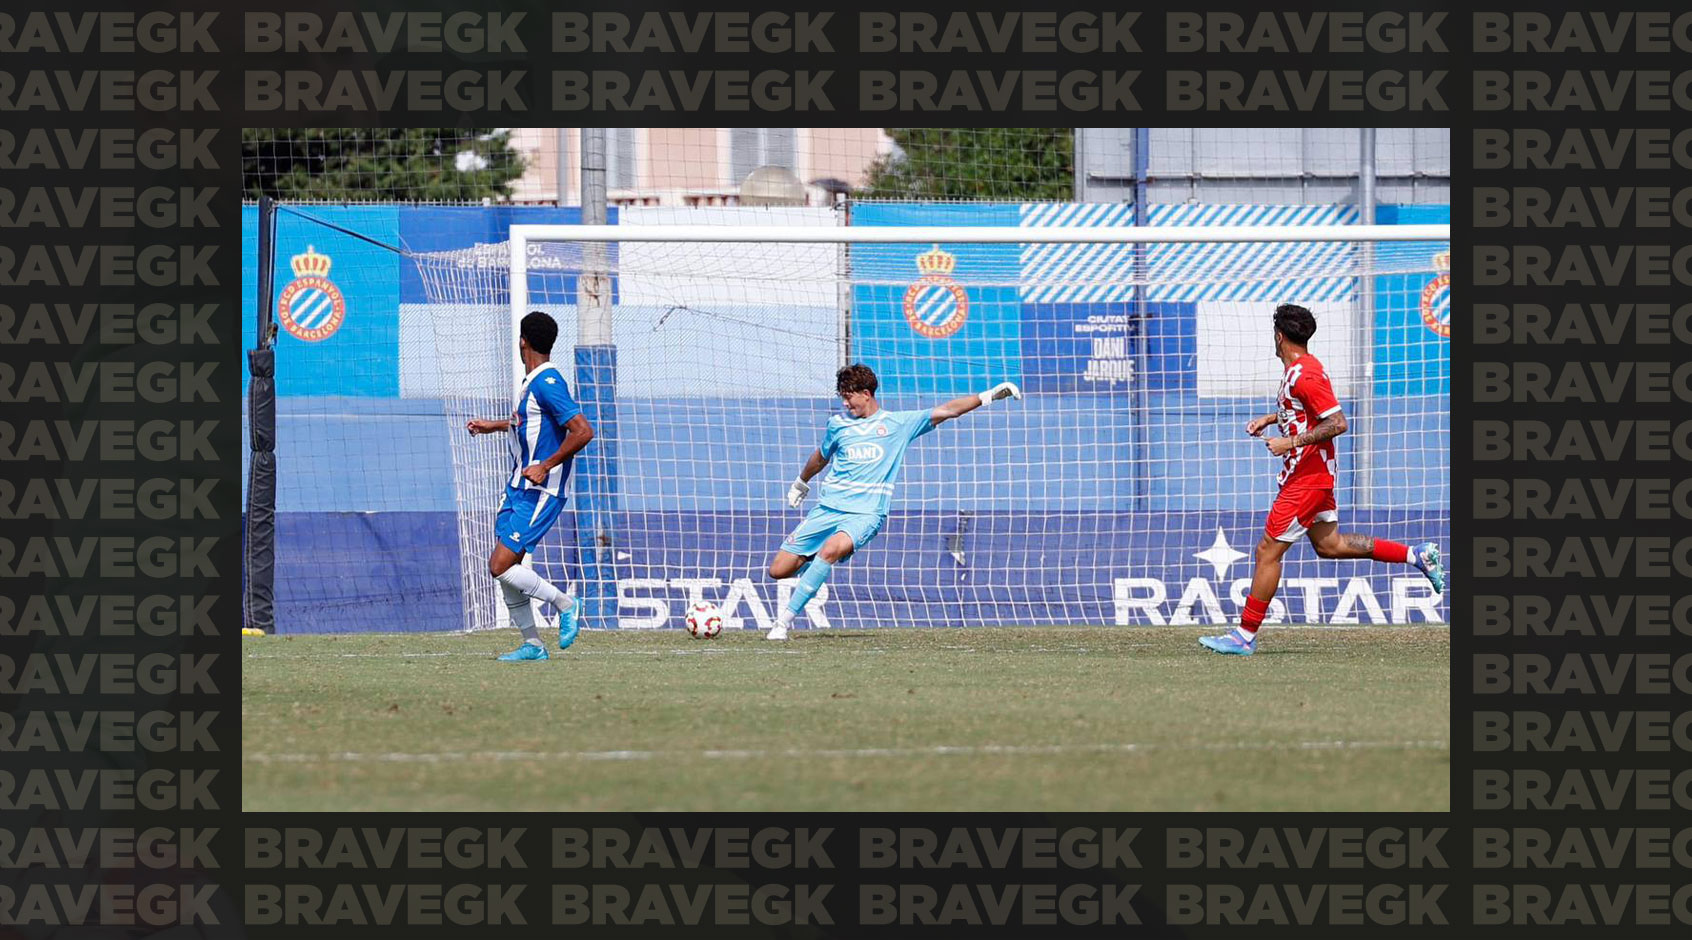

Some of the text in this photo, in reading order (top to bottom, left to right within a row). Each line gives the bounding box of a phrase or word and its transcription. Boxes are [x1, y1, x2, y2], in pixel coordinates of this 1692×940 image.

[1093, 337, 1125, 359] DANI
[1083, 360, 1135, 385] JARQUE
[847, 446, 877, 460] DANI
[495, 577, 832, 630] STAR
